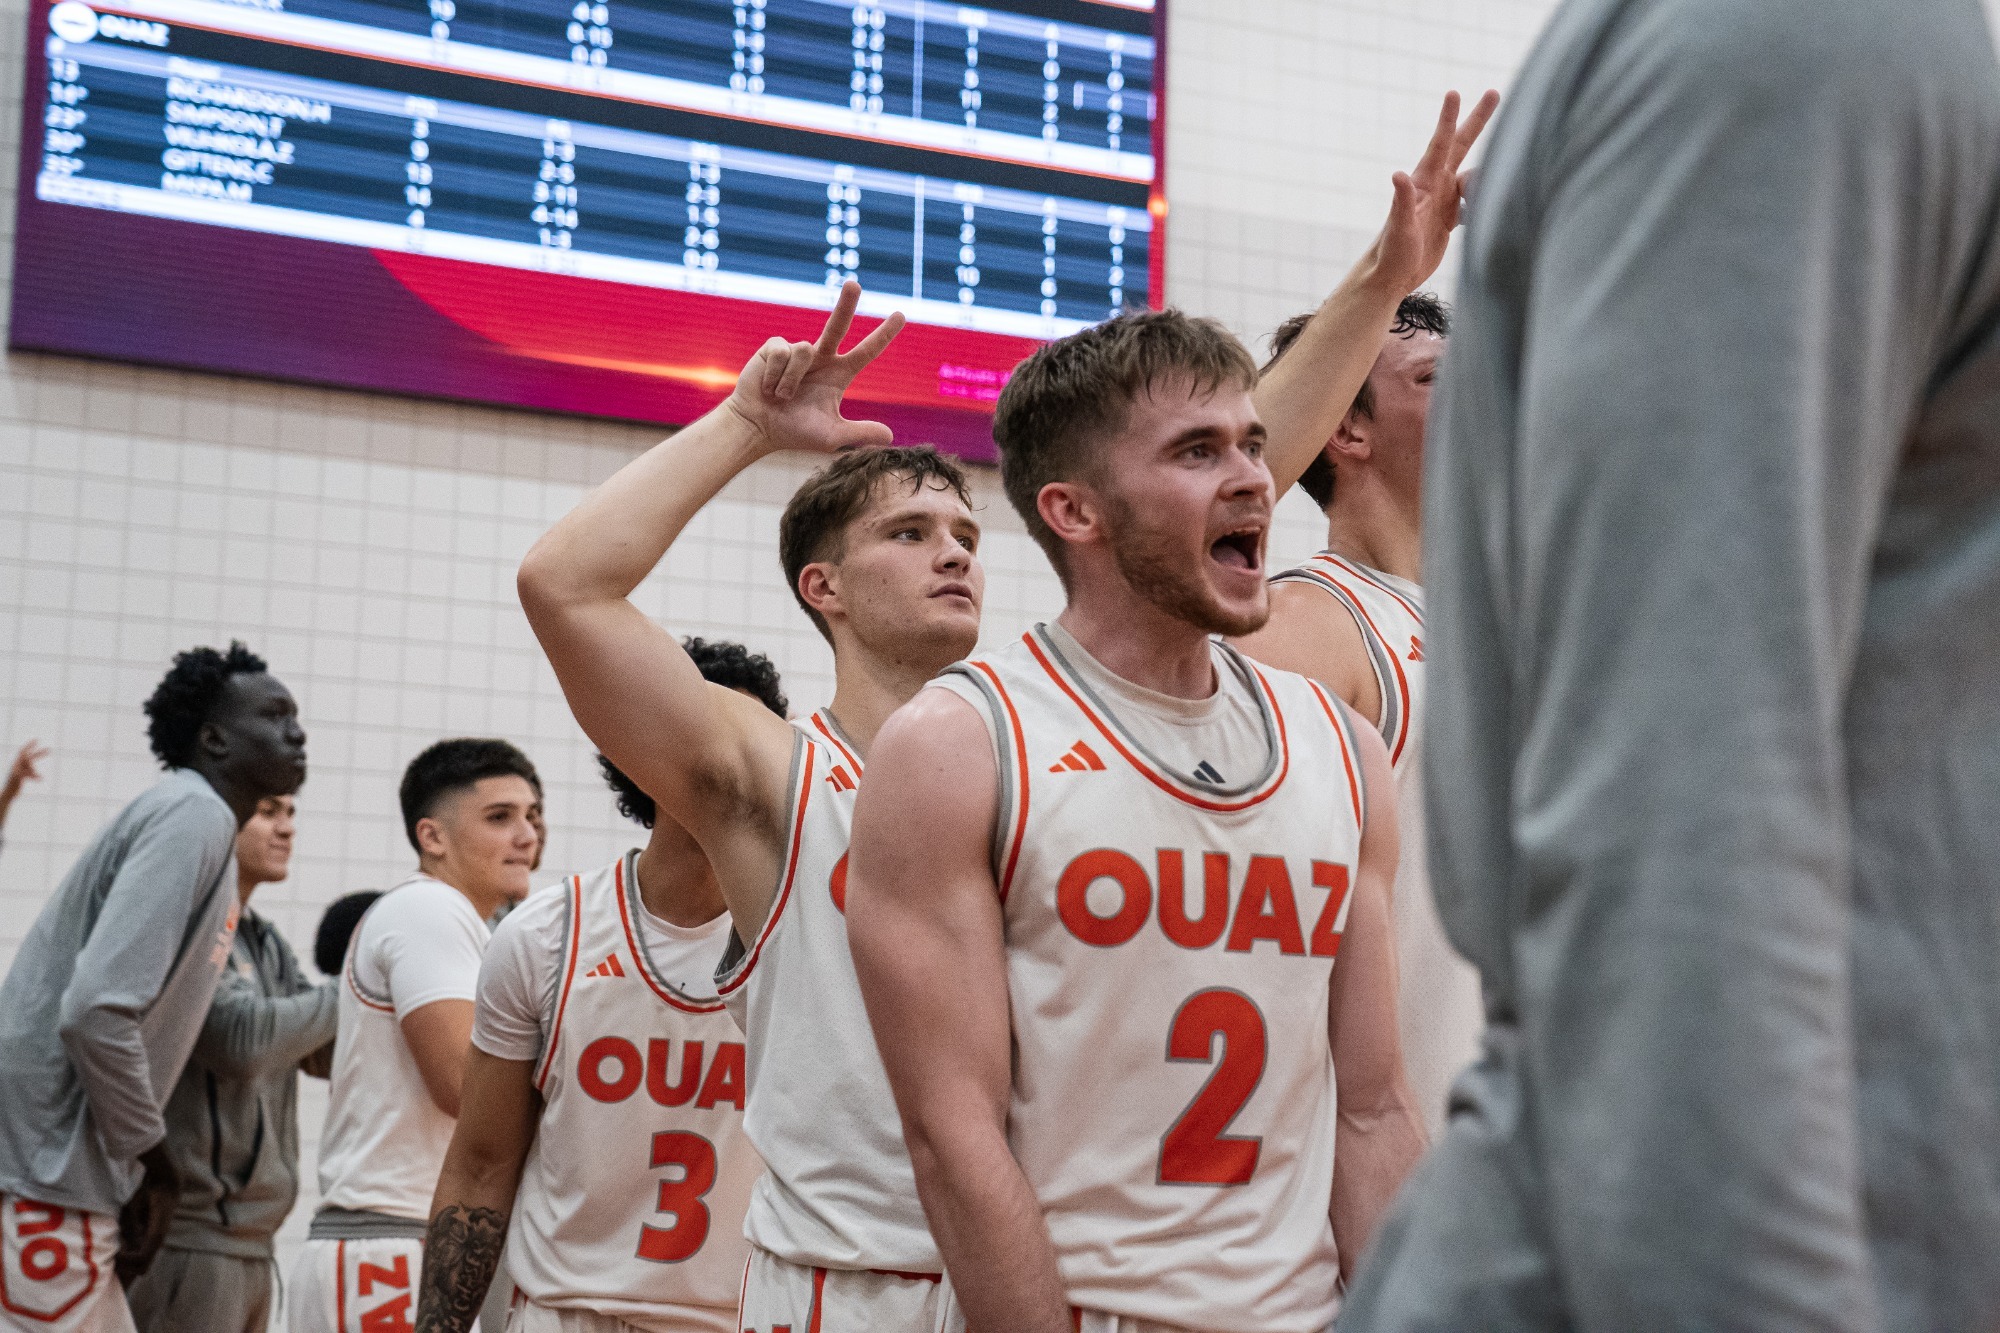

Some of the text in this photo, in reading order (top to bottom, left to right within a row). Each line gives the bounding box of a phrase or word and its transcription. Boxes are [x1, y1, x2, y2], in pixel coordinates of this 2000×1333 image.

[1055, 846, 1351, 959] OUAZ
[577, 1035, 746, 1112] OUA
[1155, 985, 1268, 1187] 2
[15, 1200, 69, 1281] OU
[634, 1129, 718, 1264] 3
[358, 1254, 415, 1333] AZ
